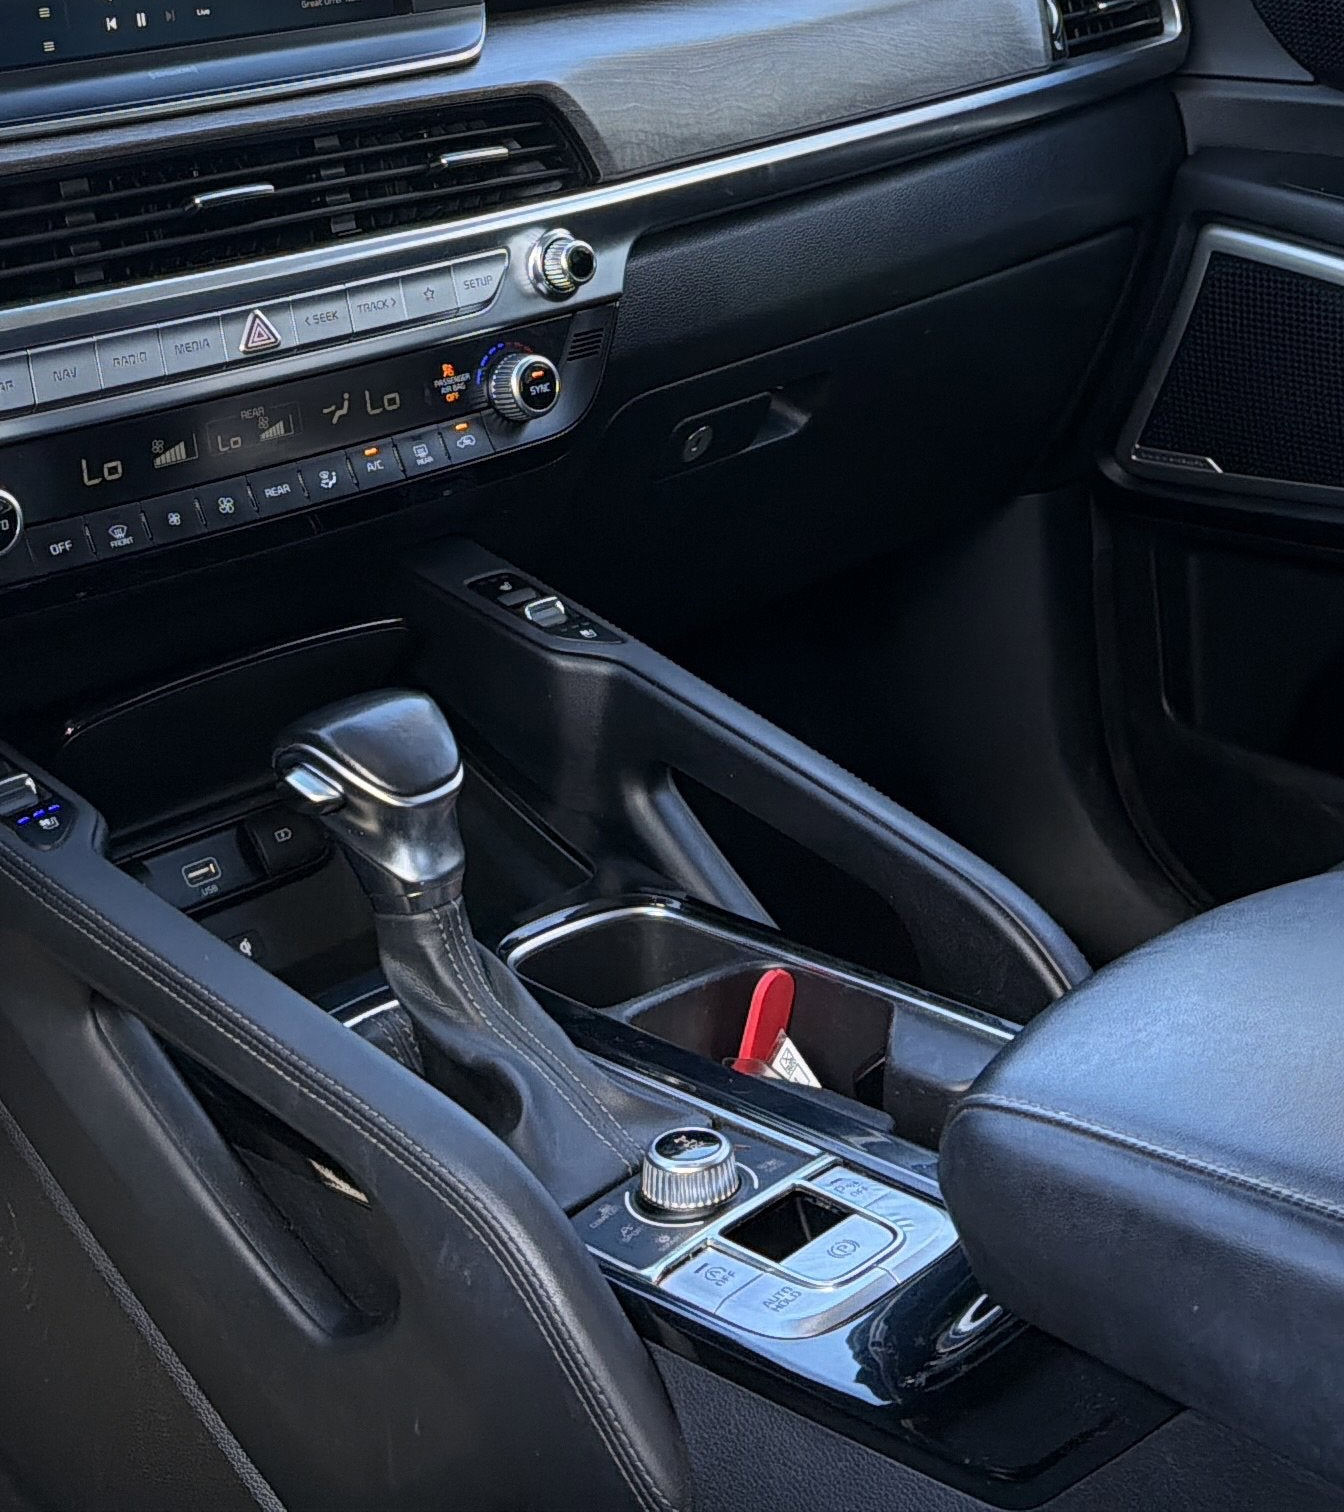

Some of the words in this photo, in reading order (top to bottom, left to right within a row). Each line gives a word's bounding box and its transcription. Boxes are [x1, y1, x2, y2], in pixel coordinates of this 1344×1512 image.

[463, 275, 493, 291] SETUP
[174, 338, 211, 355] MEDIA
[112, 351, 147, 368] RADIO
[52, 367, 77, 382] NAV
[529, 382, 551, 396] SYNC
[240, 406, 265, 420] REAR
[366, 460, 385, 472] A/C
[264, 484, 291, 498] REAR
[49, 540, 73, 556] OFF
[716, 1270, 737, 1286] OFF
[763, 1286, 794, 1308] AUTO
[771, 1291, 802, 1313] HOLD
